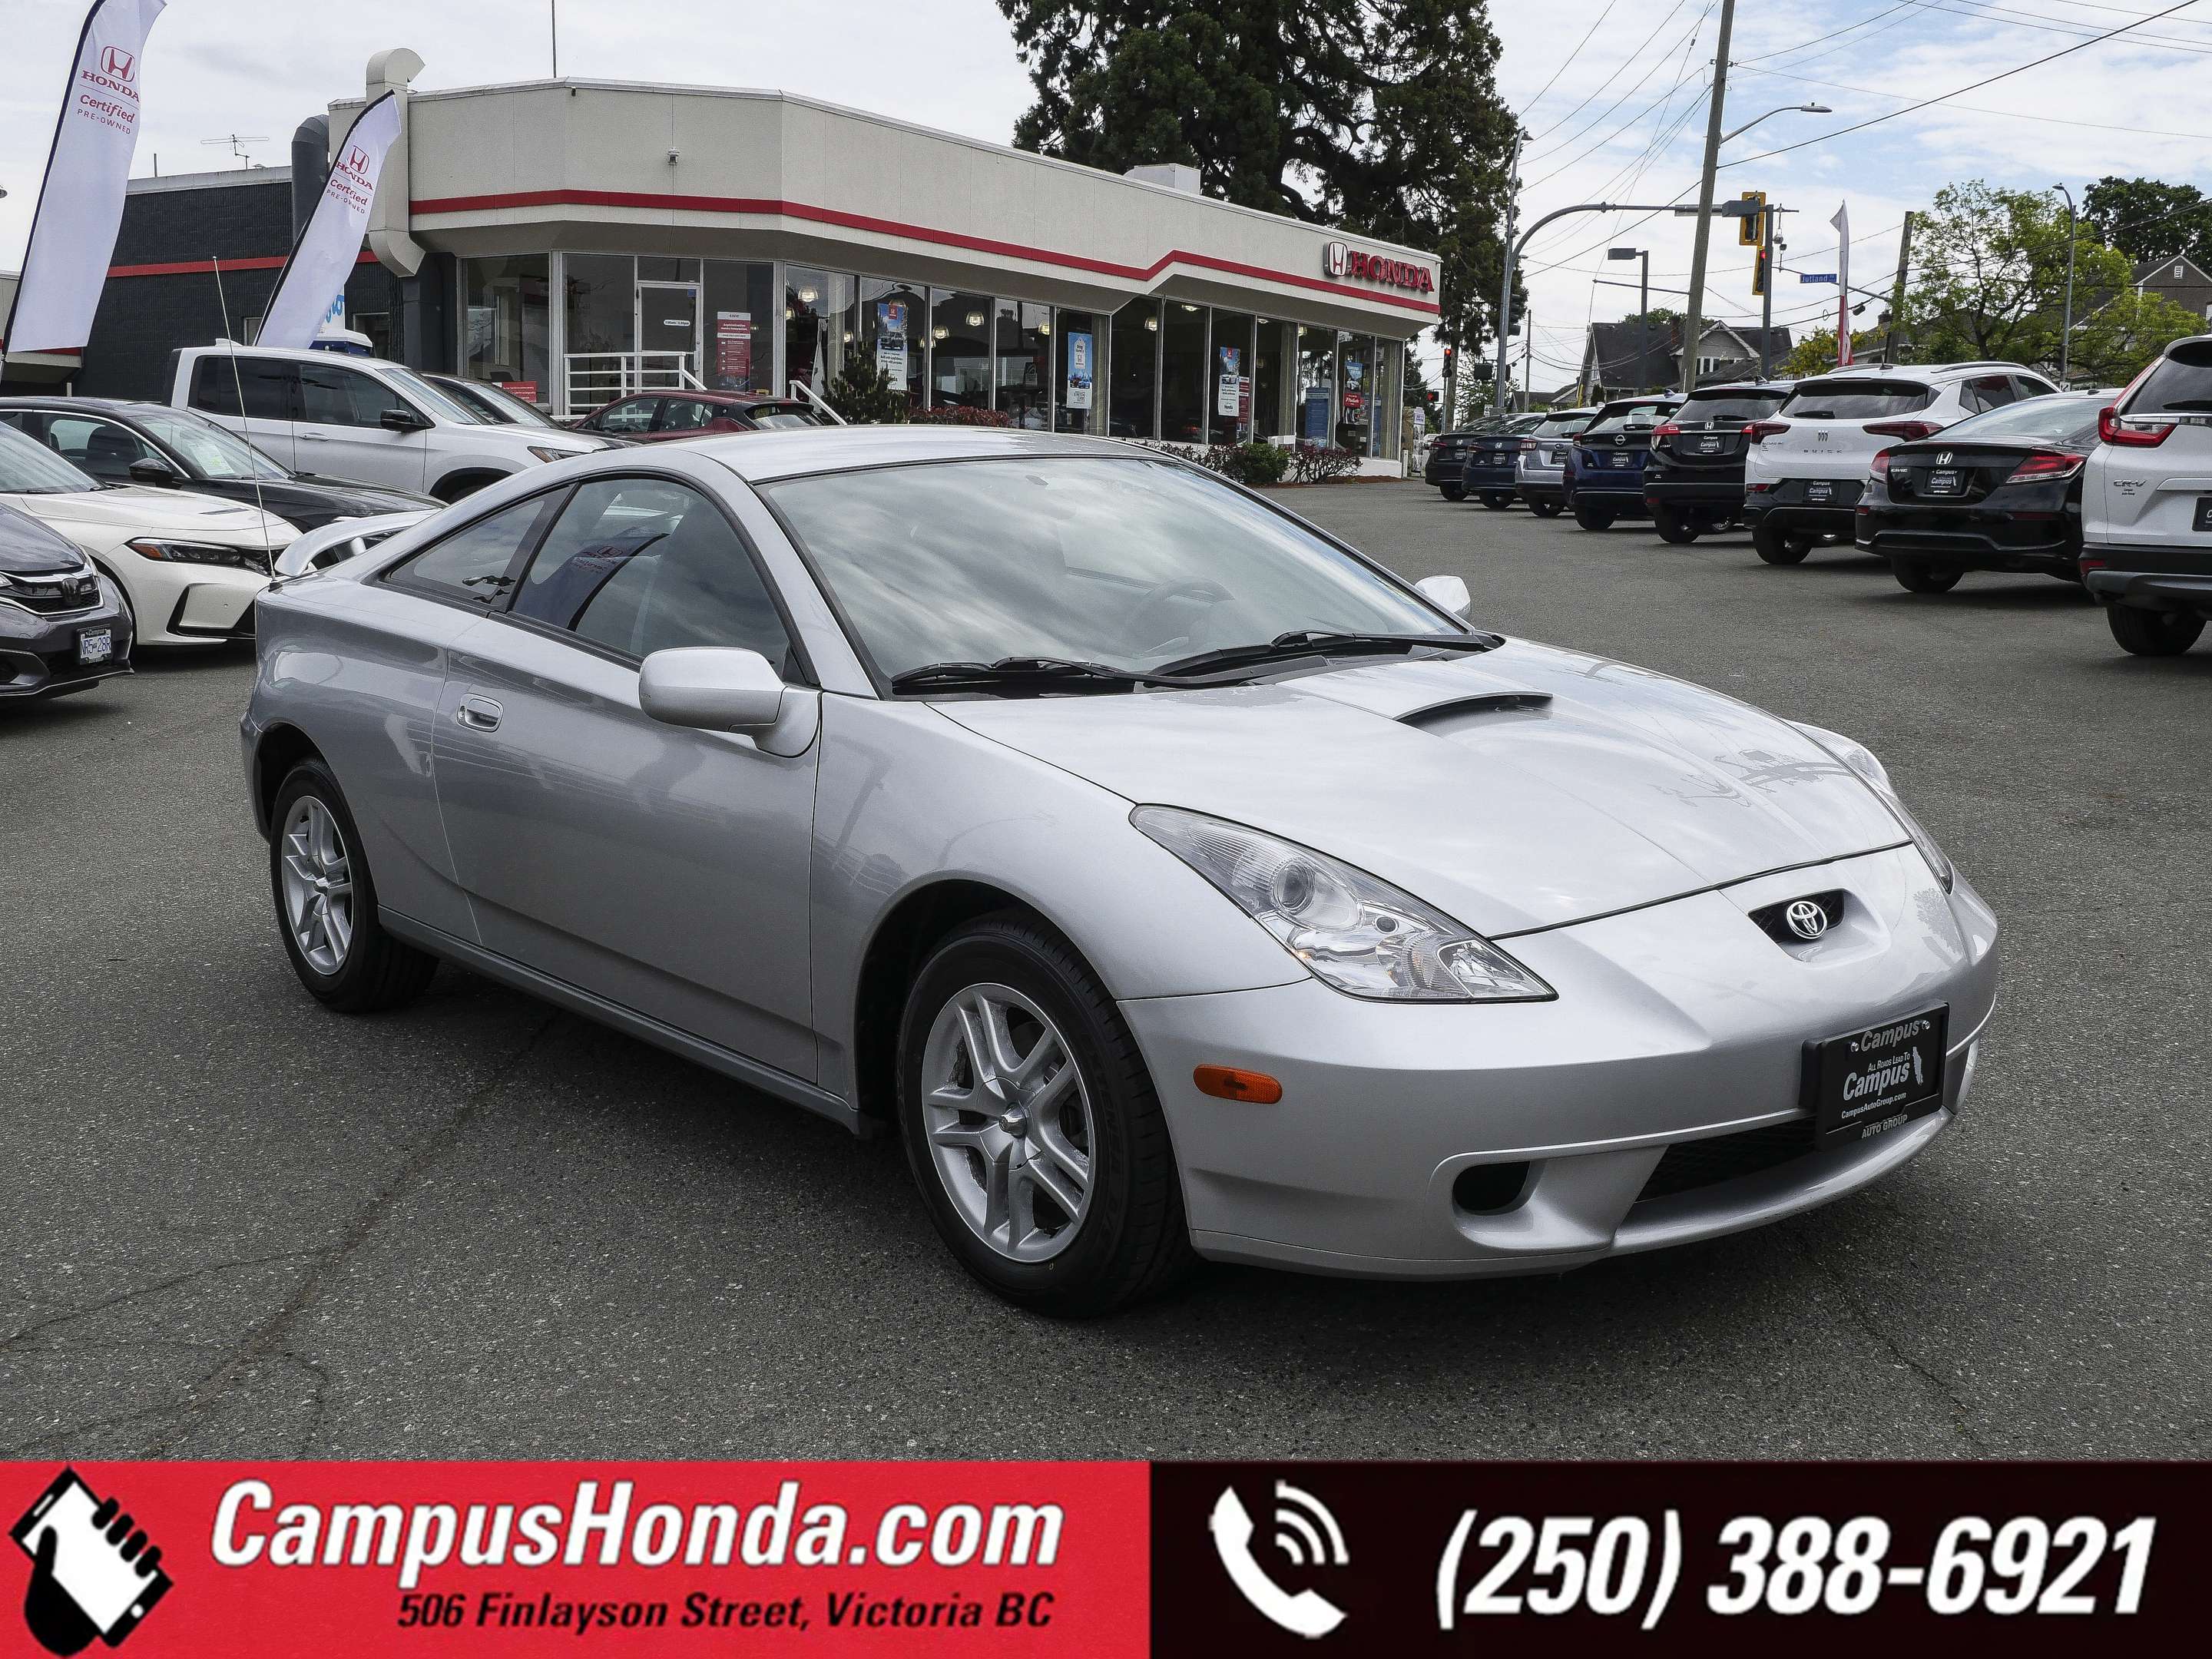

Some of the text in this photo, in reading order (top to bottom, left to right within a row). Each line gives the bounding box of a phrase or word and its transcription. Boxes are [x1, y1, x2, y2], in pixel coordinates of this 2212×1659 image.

[81, 70, 140, 103] HONDA
[77, 108, 131, 134] PRE-OWNED
[80, 94, 135, 124] Certified
[330, 179, 368, 205] Certfied
[1350, 250, 1435, 293] HONDA
[1802, 274, 1828, 283] Jutland
[1861, 1020, 1919, 1051] Campus
[1843, 1062, 1910, 1101] Campus
[1841, 1091, 1907, 1120] CampusAutoGroup.com
[1862, 1114, 1908, 1139] AUTO GROUP
